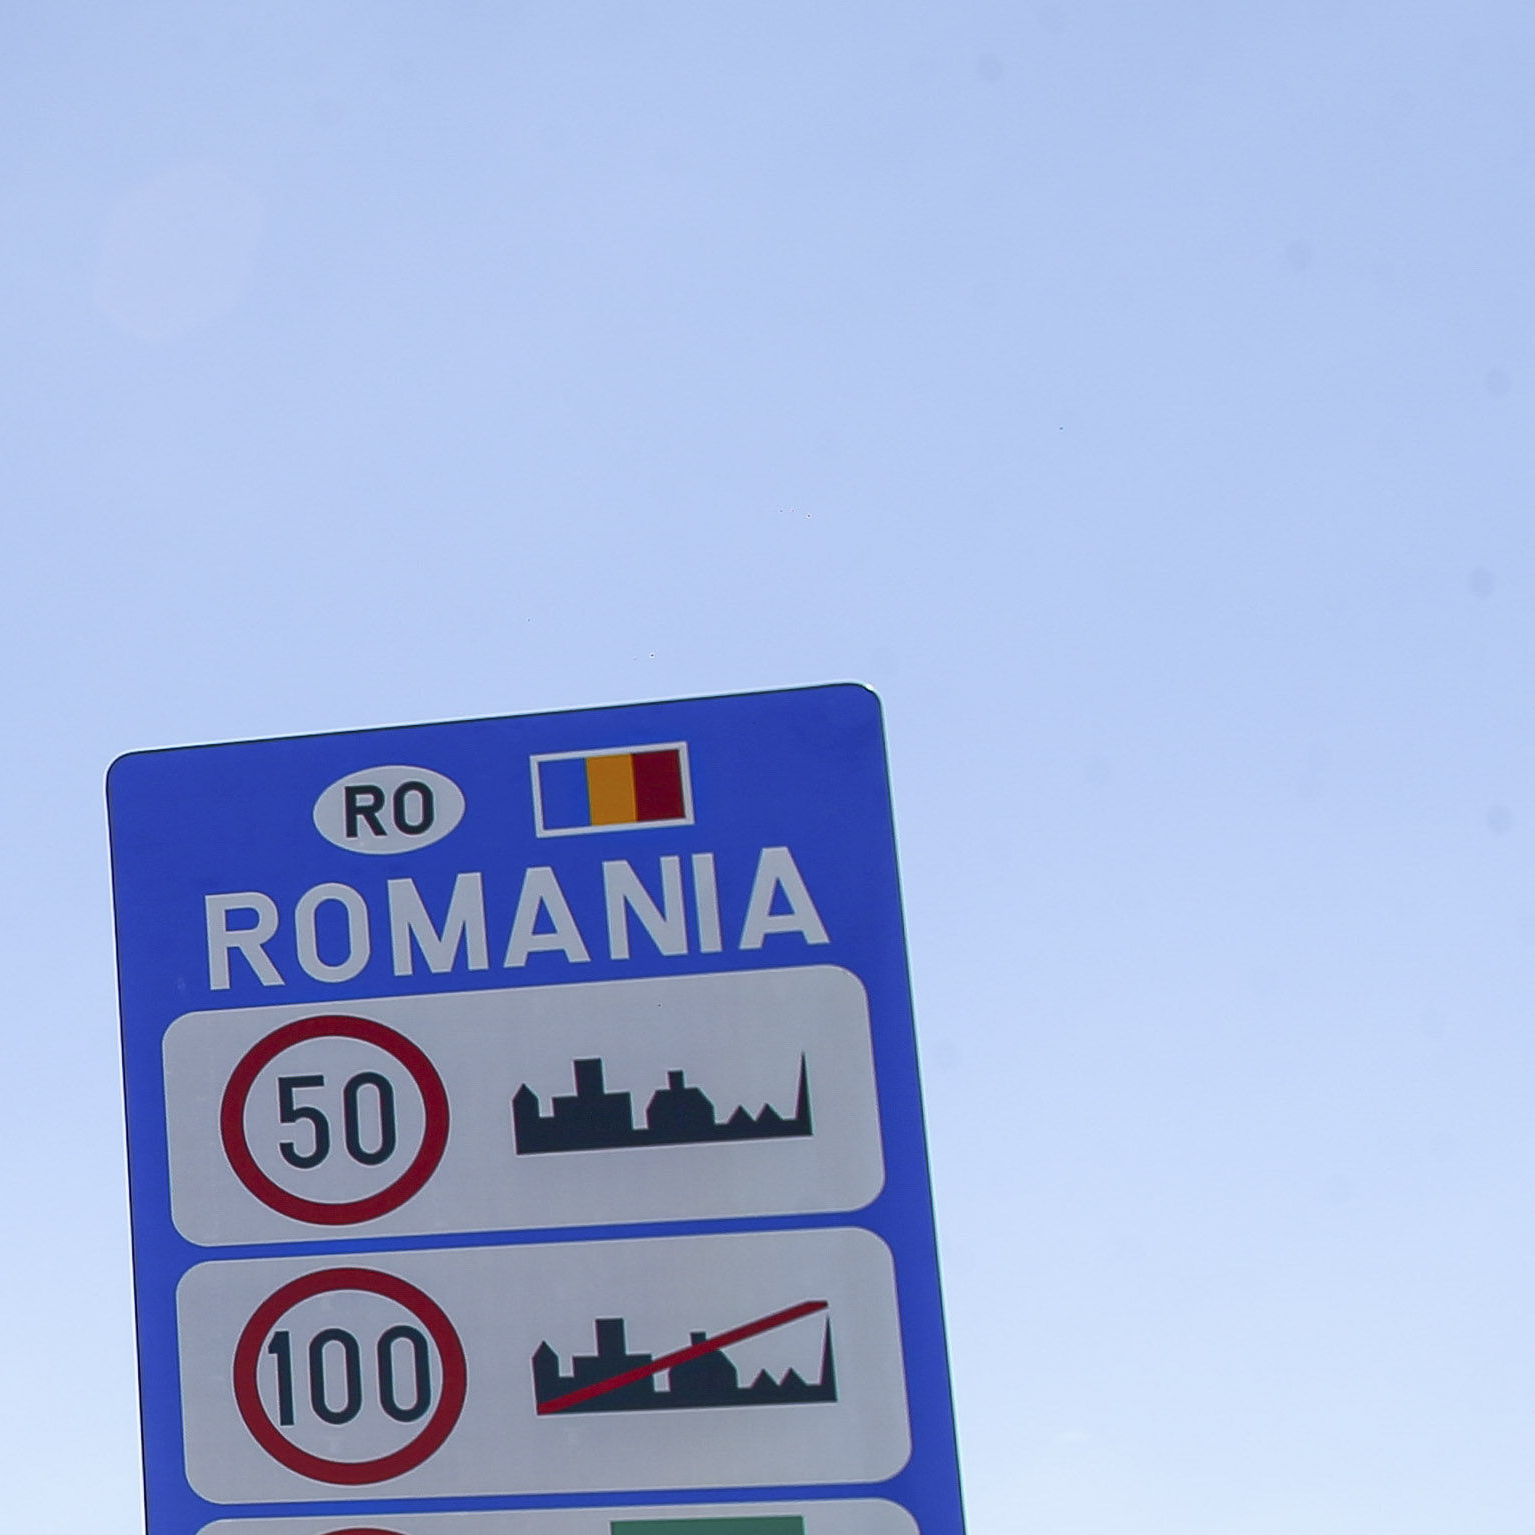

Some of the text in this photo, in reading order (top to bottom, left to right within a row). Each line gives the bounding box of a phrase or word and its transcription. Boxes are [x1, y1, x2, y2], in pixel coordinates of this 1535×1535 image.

[343, 779, 435, 839] RO
[203, 845, 832, 992] ROMANIA
[276, 1070, 397, 1170] 50
[266, 1324, 432, 1427] 100
